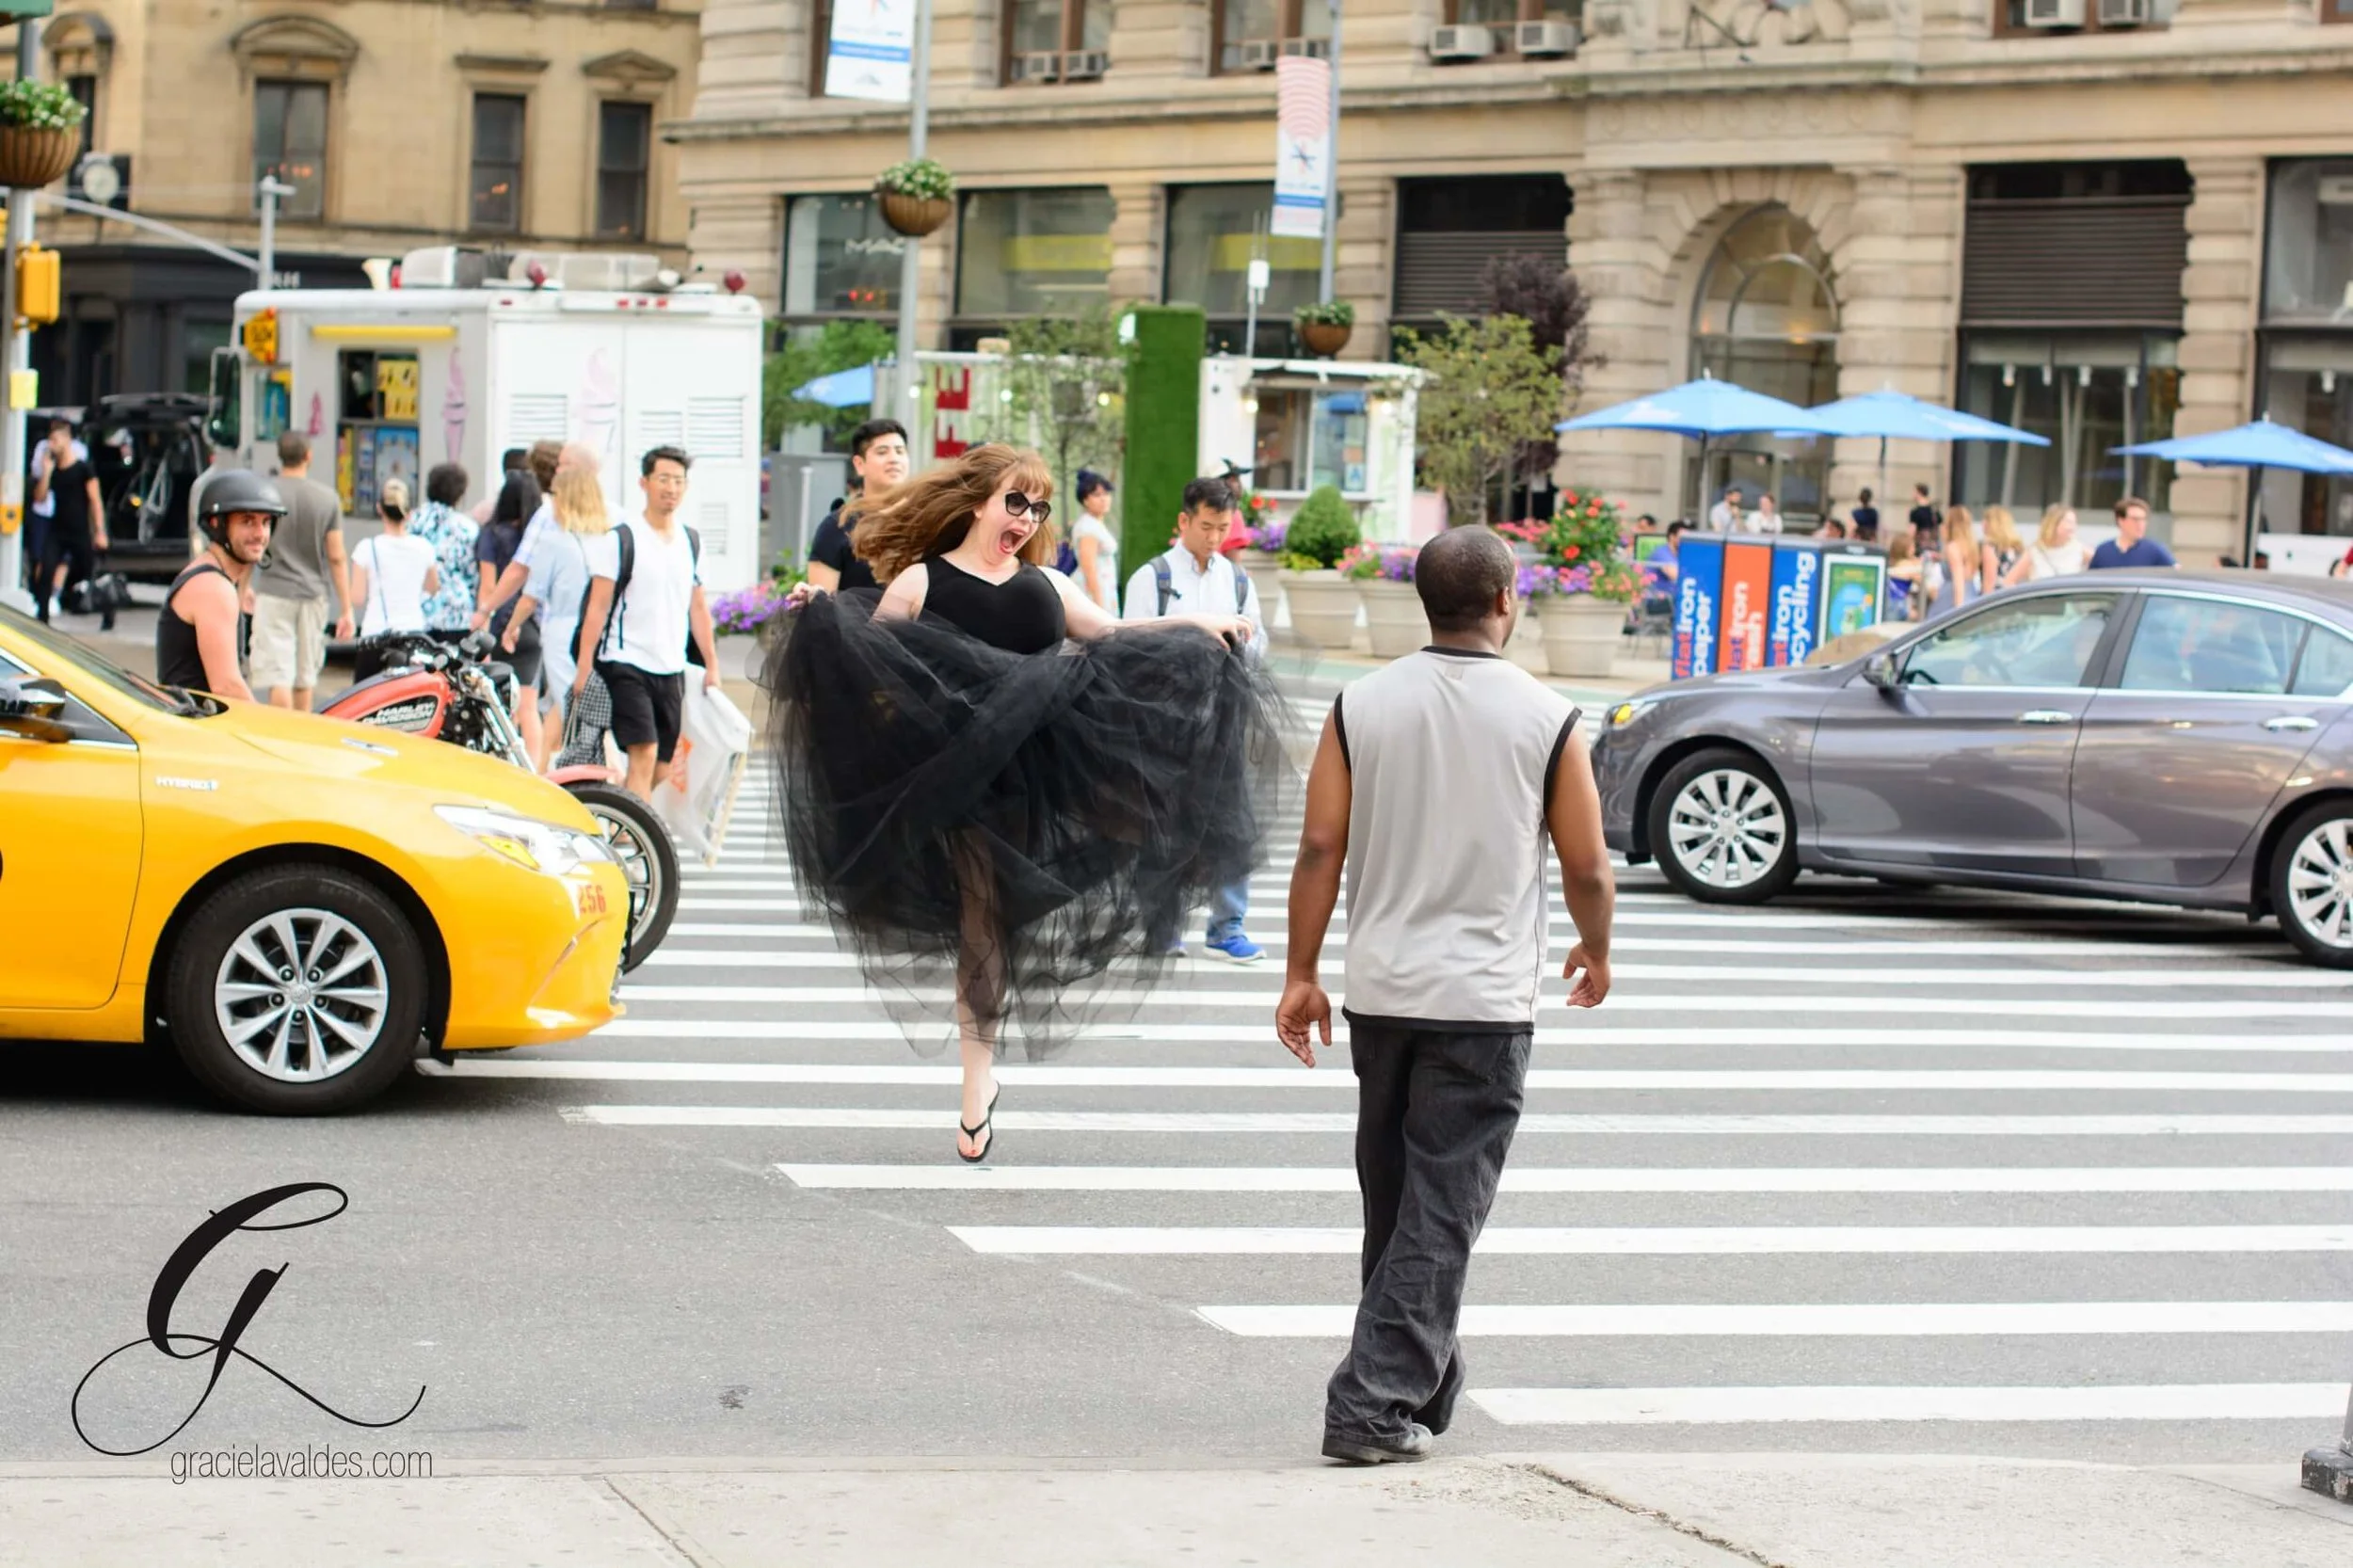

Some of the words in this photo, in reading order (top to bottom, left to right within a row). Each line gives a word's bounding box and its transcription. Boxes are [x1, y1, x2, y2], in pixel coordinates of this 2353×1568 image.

[1674, 577, 1697, 678] flatiron
[1693, 590, 1714, 678] paper
[155, 776, 207, 791] HYBRID
[577, 884, 607, 914] 256
